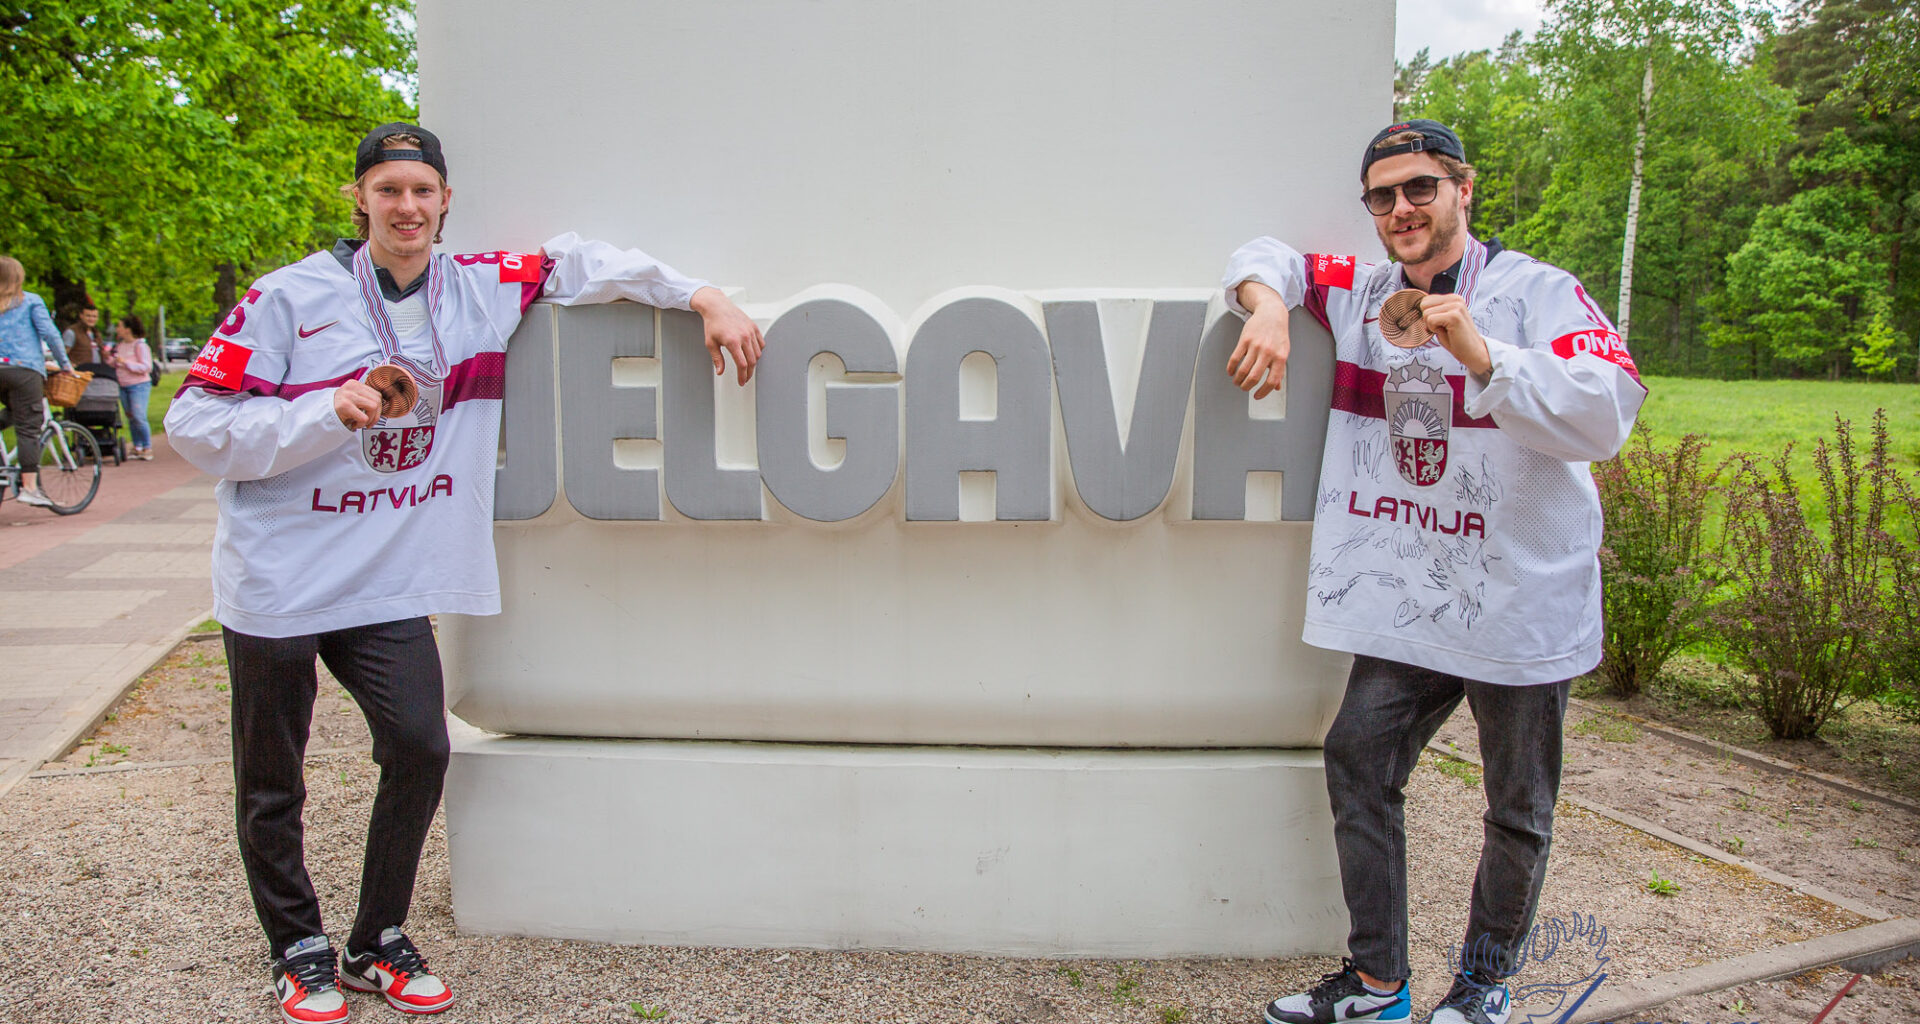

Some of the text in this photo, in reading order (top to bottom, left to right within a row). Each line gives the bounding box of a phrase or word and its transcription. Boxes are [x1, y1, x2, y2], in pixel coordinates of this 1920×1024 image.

[209, 366, 227, 380] Bar
[493, 298, 1337, 523] JELGAVA
[312, 474, 453, 514] LATVIJA
[1348, 491, 1486, 540] LATVIJA
